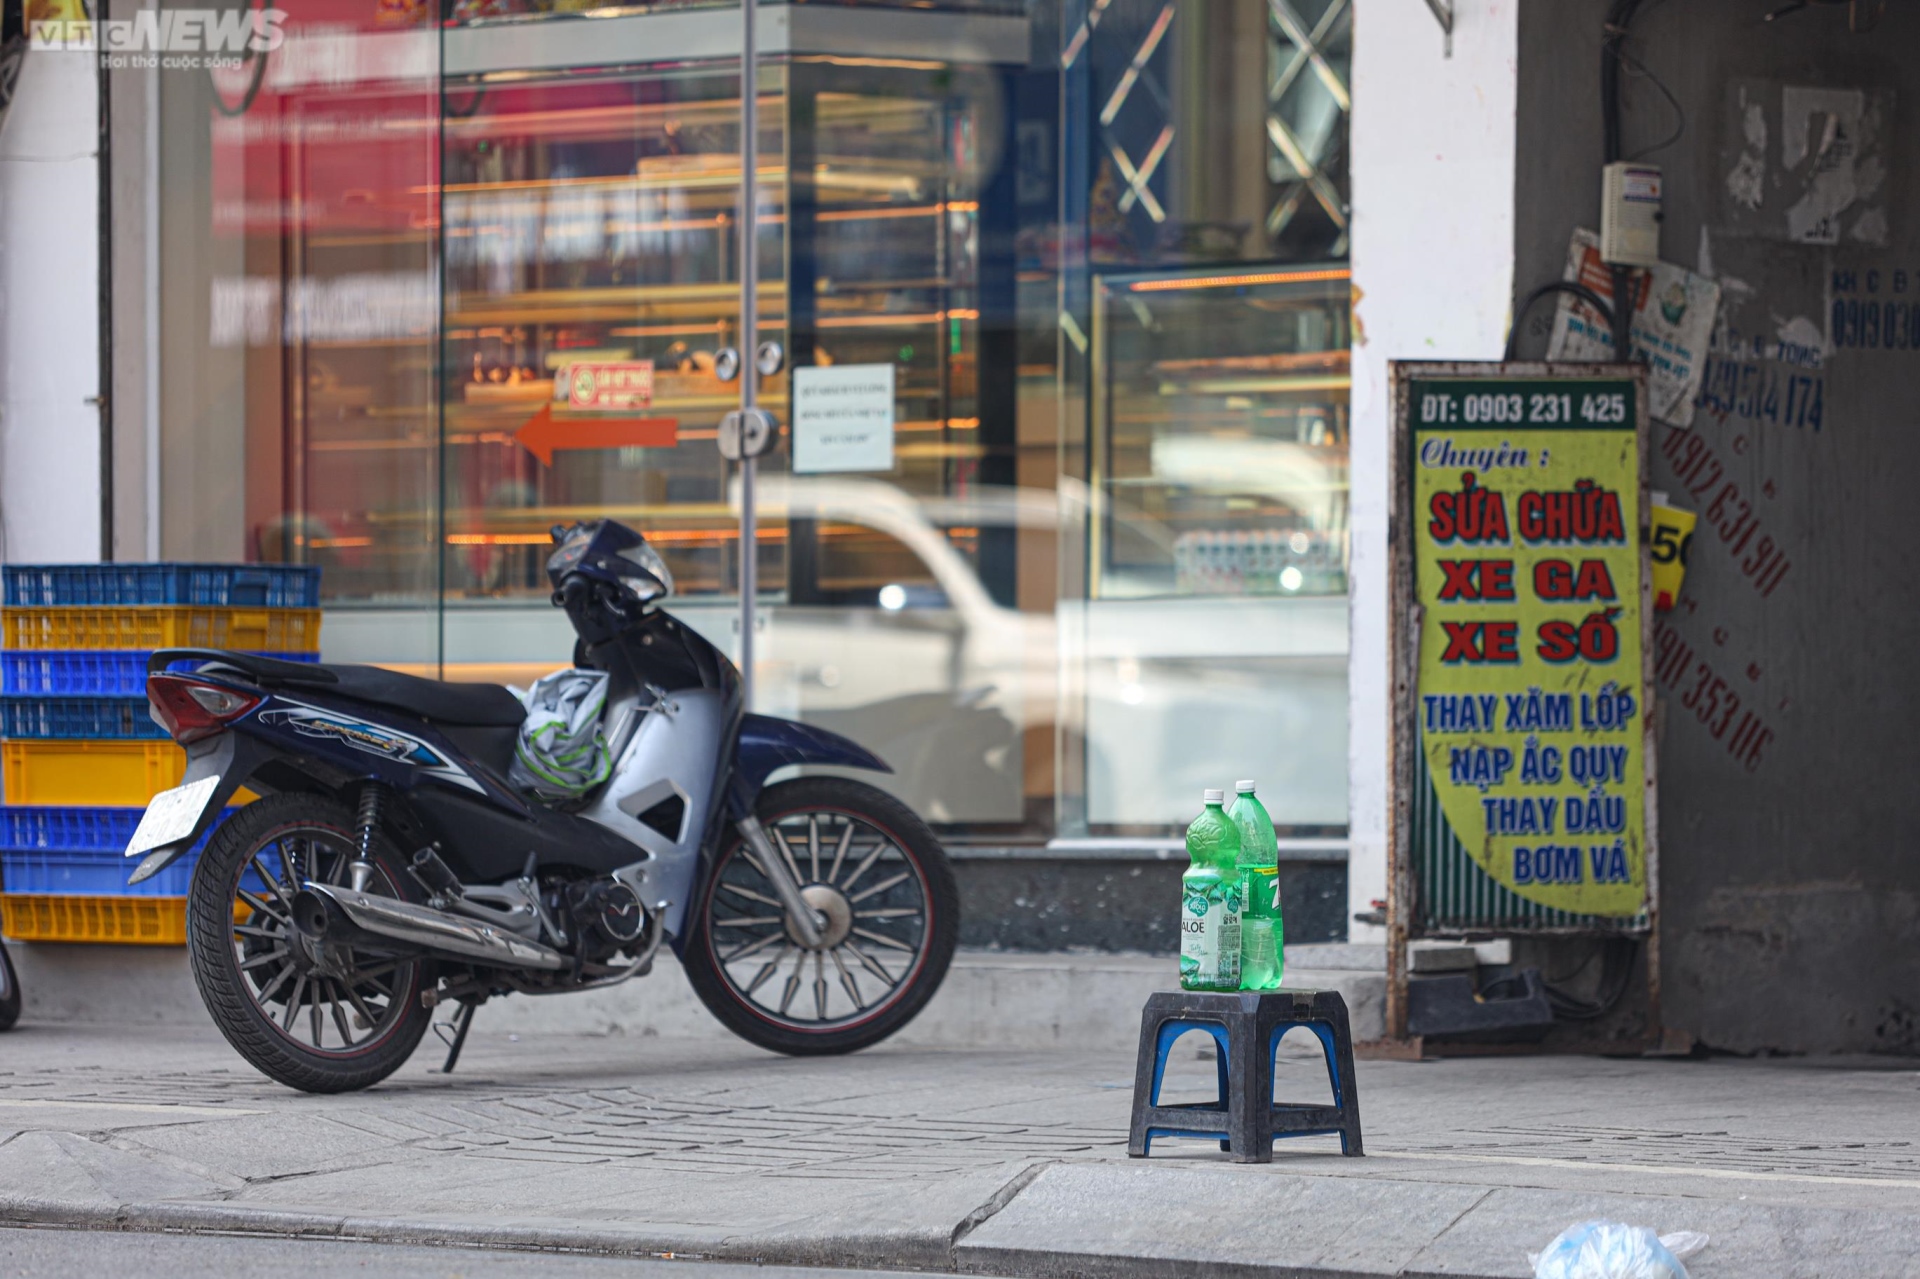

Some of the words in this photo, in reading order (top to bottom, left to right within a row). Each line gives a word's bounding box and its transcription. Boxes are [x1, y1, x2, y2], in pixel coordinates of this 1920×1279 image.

[1463, 394, 1523, 423] 0903
[1529, 394, 1571, 423] 231
[1580, 394, 1625, 423] 425
[1420, 438, 1529, 473] Chuyên
[1428, 470, 1511, 546] SỬA
[1517, 477, 1627, 546] CHỮA
[1437, 558, 1516, 602] XE
[1533, 558, 1617, 602] GA
[1439, 620, 1521, 665] XE
[1536, 606, 1624, 665] SỐ
[1423, 693, 1497, 732] THAY
[1504, 686, 1574, 732] XĂM
[1580, 679, 1637, 732] LỐP
[1450, 746, 1514, 793] NẠP
[1520, 734, 1563, 784] ẮC
[1569, 745, 1628, 789] QUY
[1482, 797, 1558, 835] THAY
[1513, 843, 1583, 885] BƠM
[1590, 838, 1631, 884] VÁ
[1181, 921, 1205, 934] ALOE
